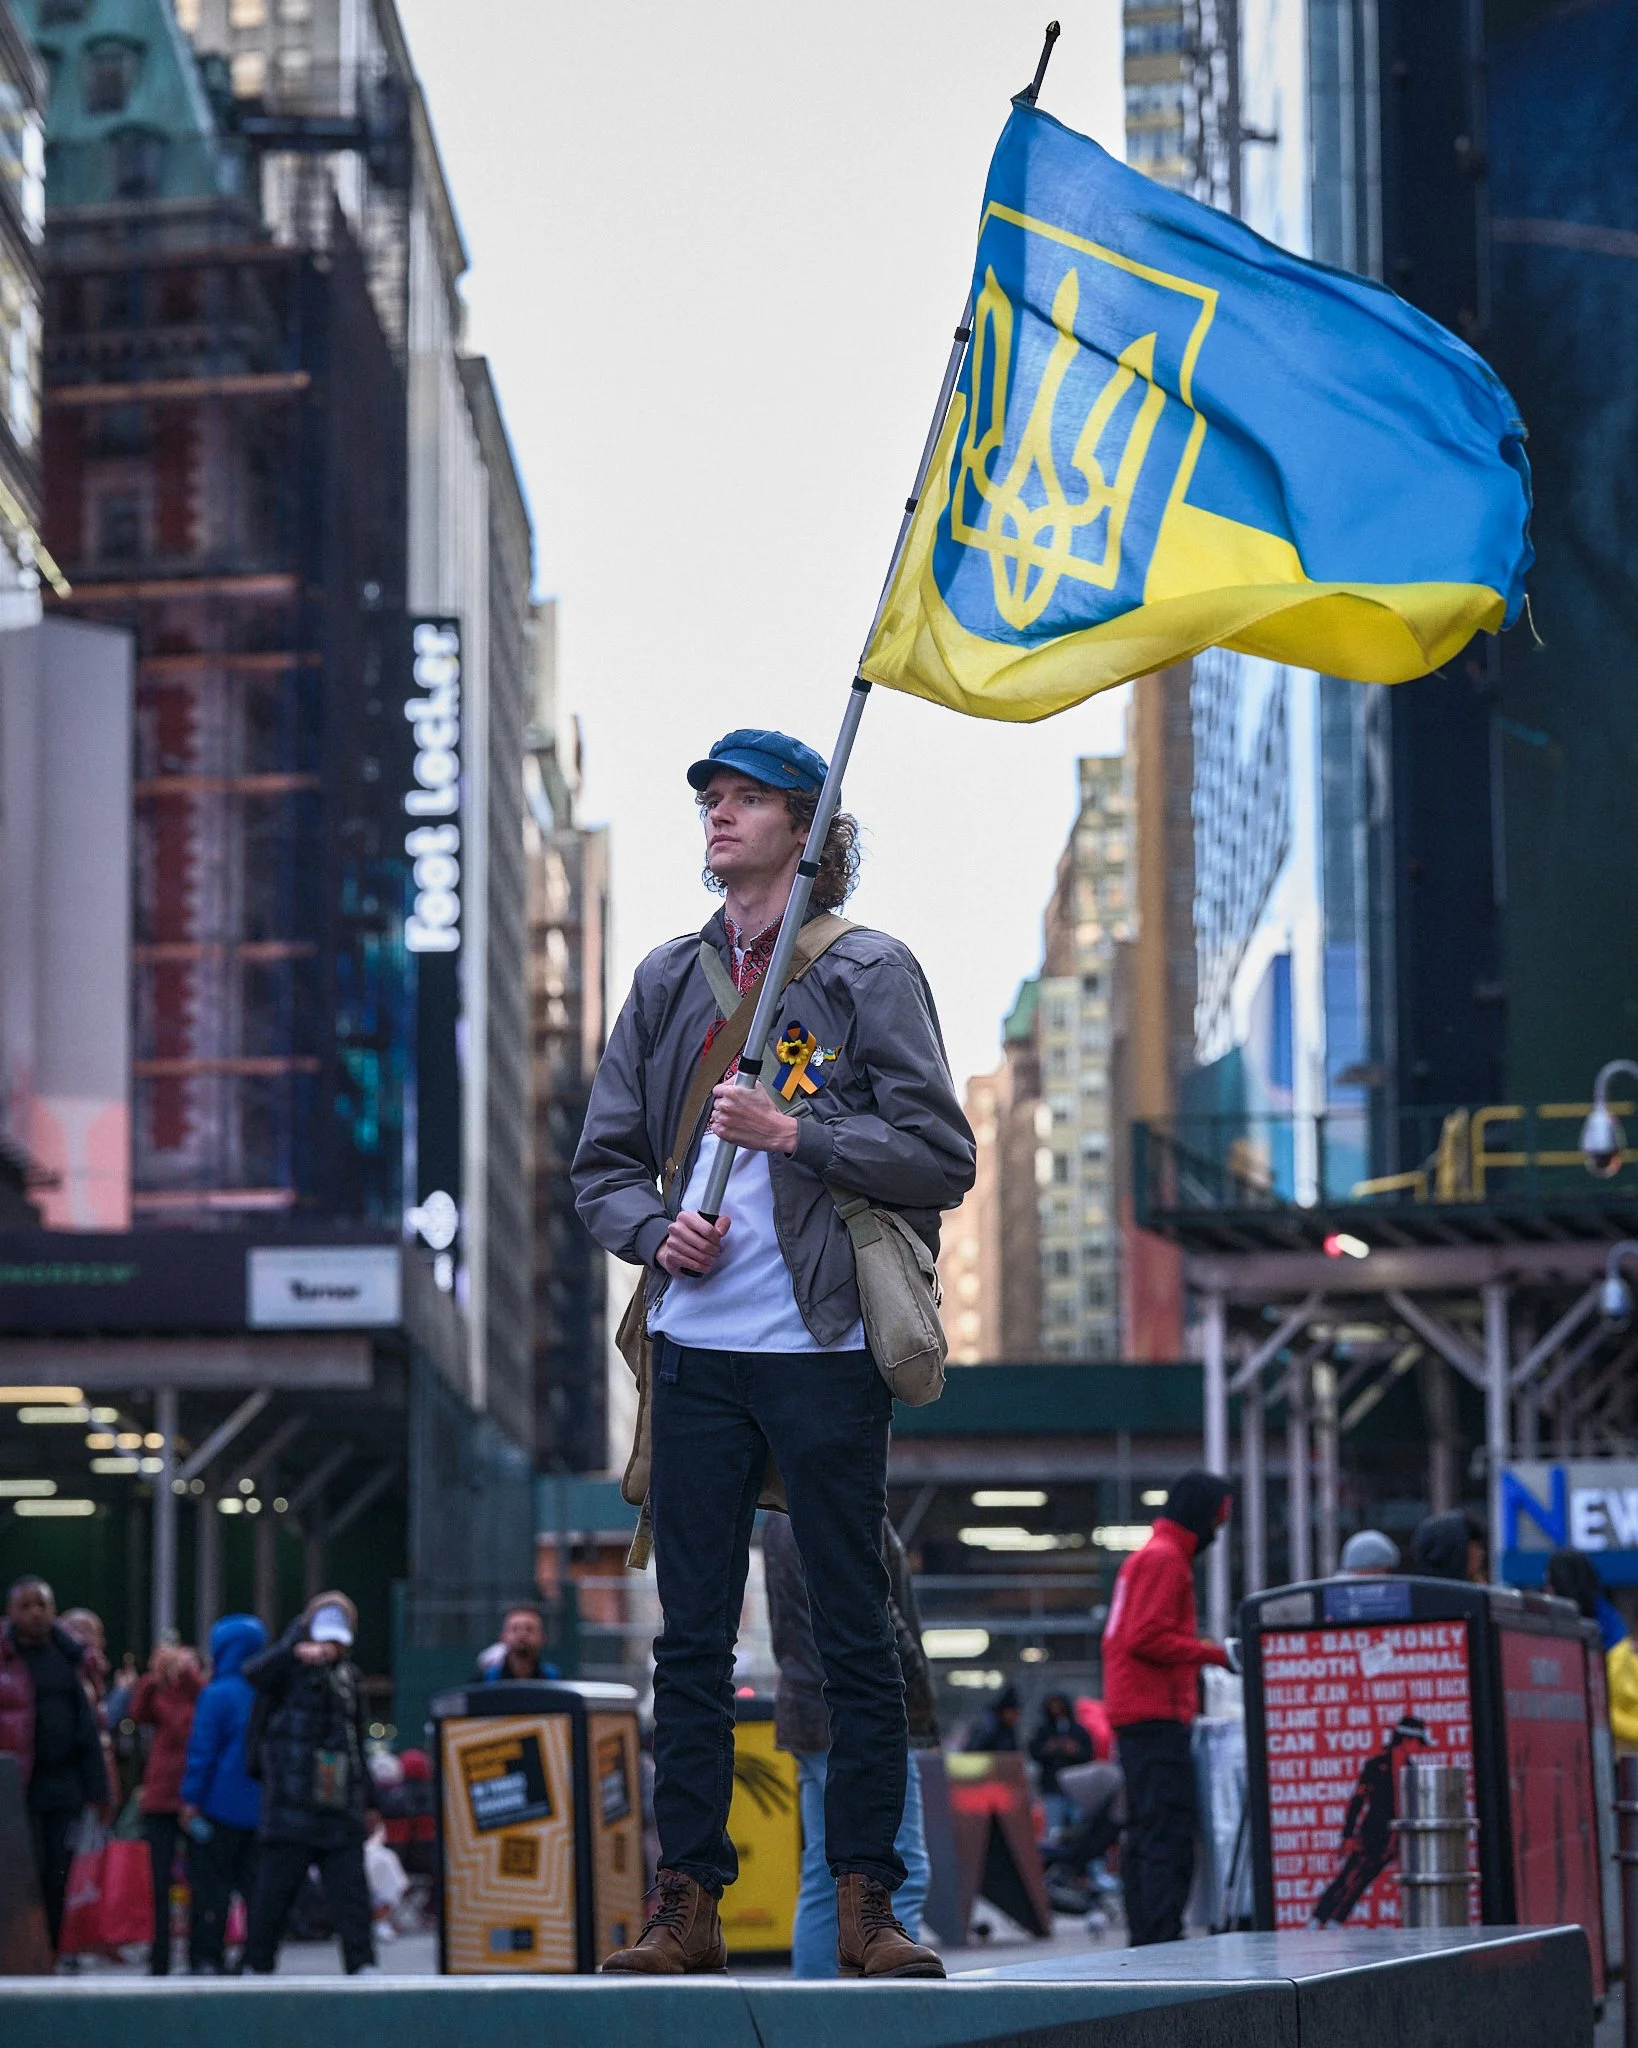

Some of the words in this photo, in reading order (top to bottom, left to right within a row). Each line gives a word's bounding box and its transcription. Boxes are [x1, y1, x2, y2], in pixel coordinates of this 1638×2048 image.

[404, 623, 460, 816] Locker
[405, 823, 460, 952] Foot
[1263, 1634, 1307, 1655] JAM
[1322, 1631, 1370, 1651] BAD
[1382, 1626, 1465, 1649] MONEY
[1264, 1656, 1356, 1679] SMOOTH
[1266, 1708, 1318, 1730] BLAME
[1324, 1706, 1341, 1727] IT
[1347, 1704, 1371, 1726] ON
[1267, 1732, 1315, 1753] CAN
[1325, 1729, 1373, 1751] YOU
[1447, 1724, 1471, 1746] IT
[1269, 1758, 1305, 1779] THEY
[1270, 1806, 1316, 1828] MAN
[1323, 1805, 1345, 1825] IN
